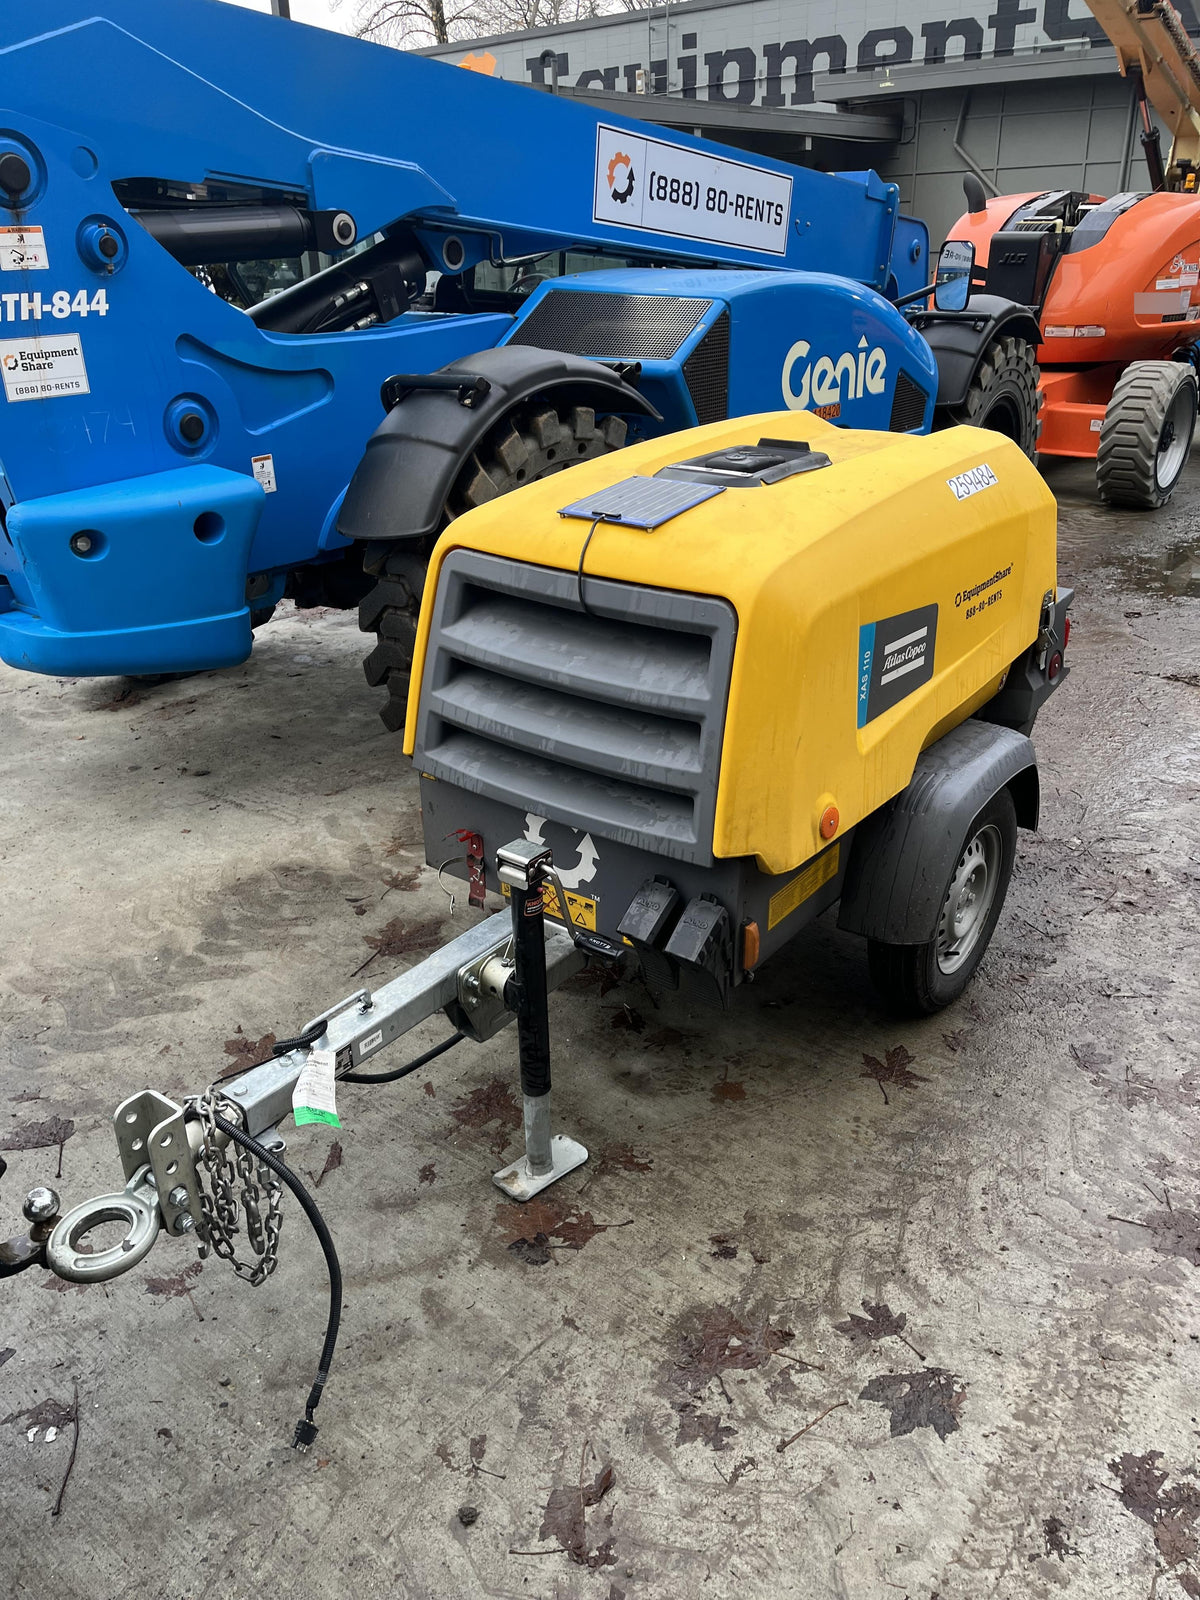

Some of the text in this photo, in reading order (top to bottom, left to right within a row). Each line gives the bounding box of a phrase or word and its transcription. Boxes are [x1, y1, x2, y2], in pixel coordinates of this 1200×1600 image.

[648, 170, 784, 226] (888) 80-RENTS
[19, 347, 79, 362] Equipment
[21, 361, 54, 372] Share
[15, 381, 81, 396] (888) 80-RENTS
[781, 334, 887, 411] Genie
[948, 464, 997, 500] 259484
[962, 565, 1012, 602] EquipmentShare
[965, 590, 1003, 619] 888-80-RENTS
[882, 642, 927, 672] Atlas Copco
[860, 650, 871, 701] XAS 110
